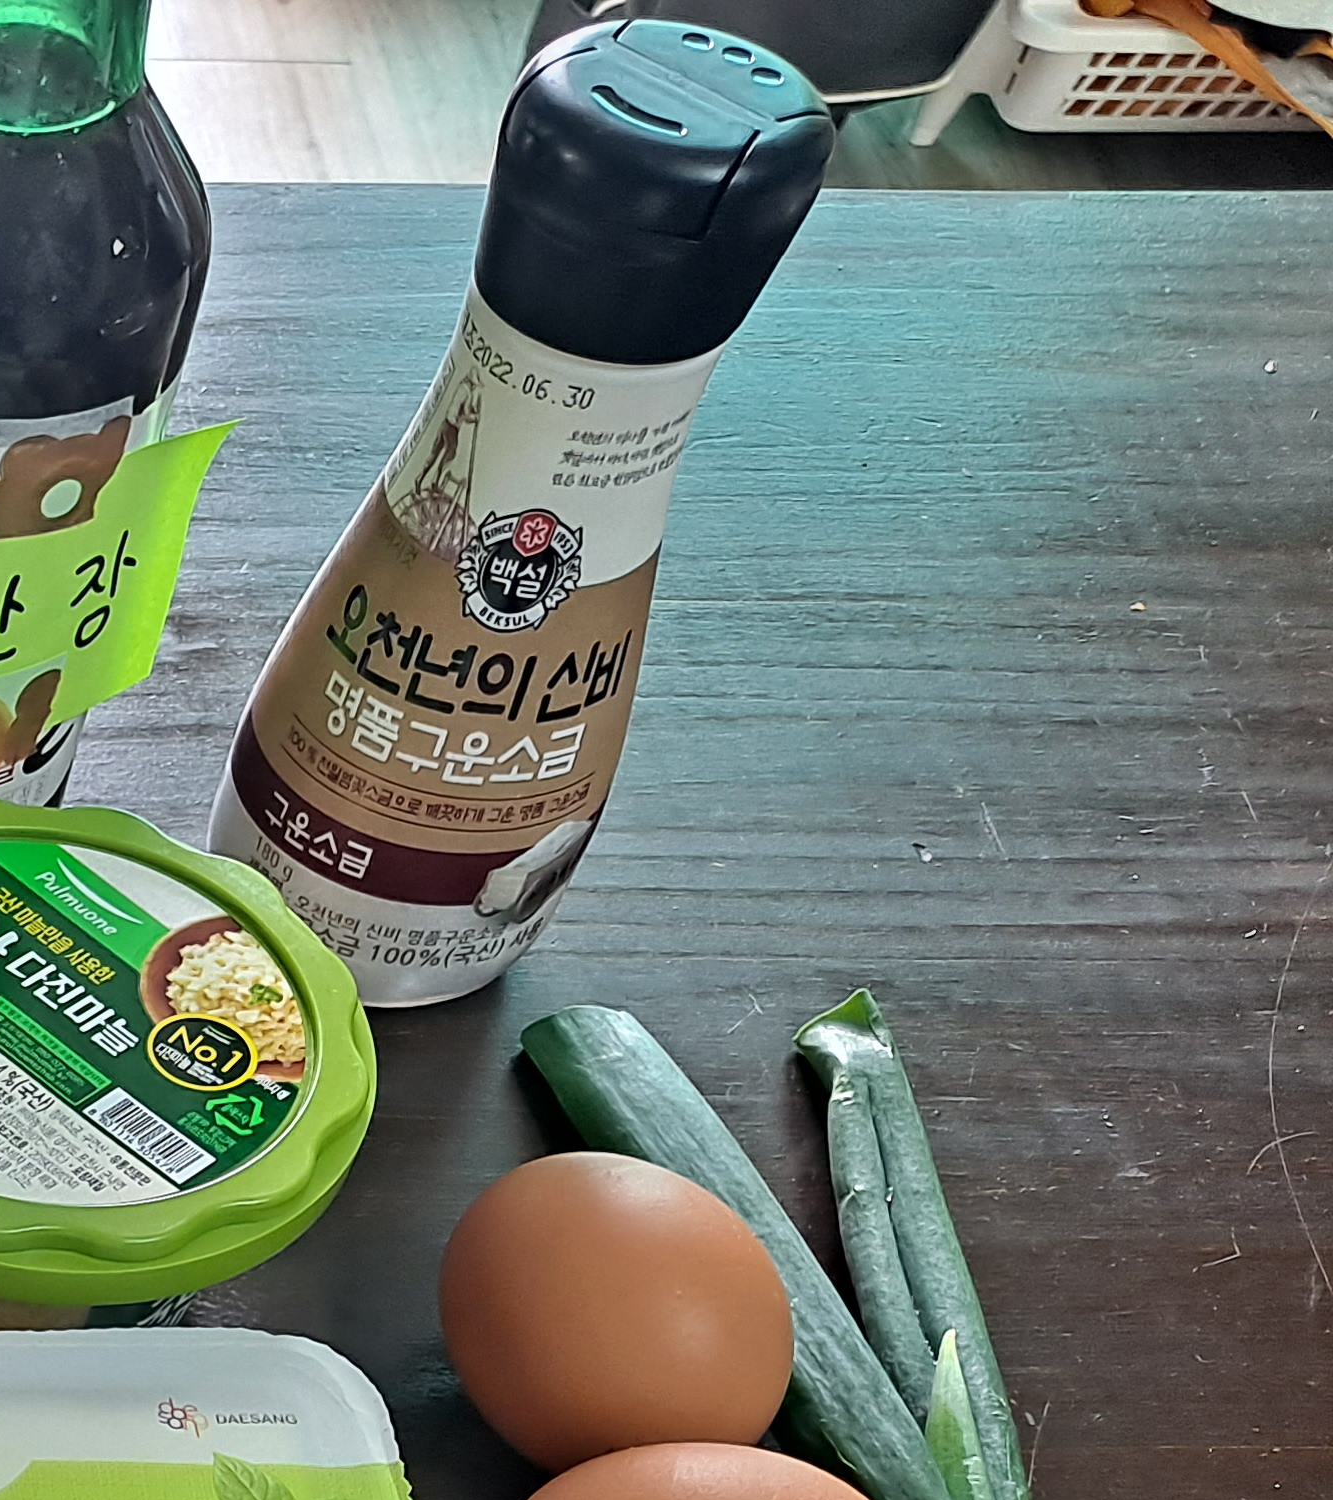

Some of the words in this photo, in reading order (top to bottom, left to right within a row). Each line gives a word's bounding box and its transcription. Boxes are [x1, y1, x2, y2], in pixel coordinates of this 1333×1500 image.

[473, 337, 595, 410] 2022.06.30
[485, 522, 514, 540] SINCE
[490, 556, 547, 599] 백설
[479, 606, 530, 628] BEKSUL
[326, 583, 538, 722] 오천년의
[536, 629, 633, 723] 신비
[324, 670, 587, 786] 명품구운소금
[255, 836, 280, 868] 180
[283, 865, 293, 883] g
[264, 791, 374, 880] 구운소금
[35, 871, 119, 936] Pulmuone
[13, 905, 76, 956] 마늘만을
[65, 947, 118, 986] 사용한
[366, 923, 402, 943] 신비
[370, 936, 507, 968] 100%(국산)
[5, 950, 140, 1058] 다진마늘
[167, 1024, 244, 1073] No.1
[215, 1413, 298, 1425] DAESANG
